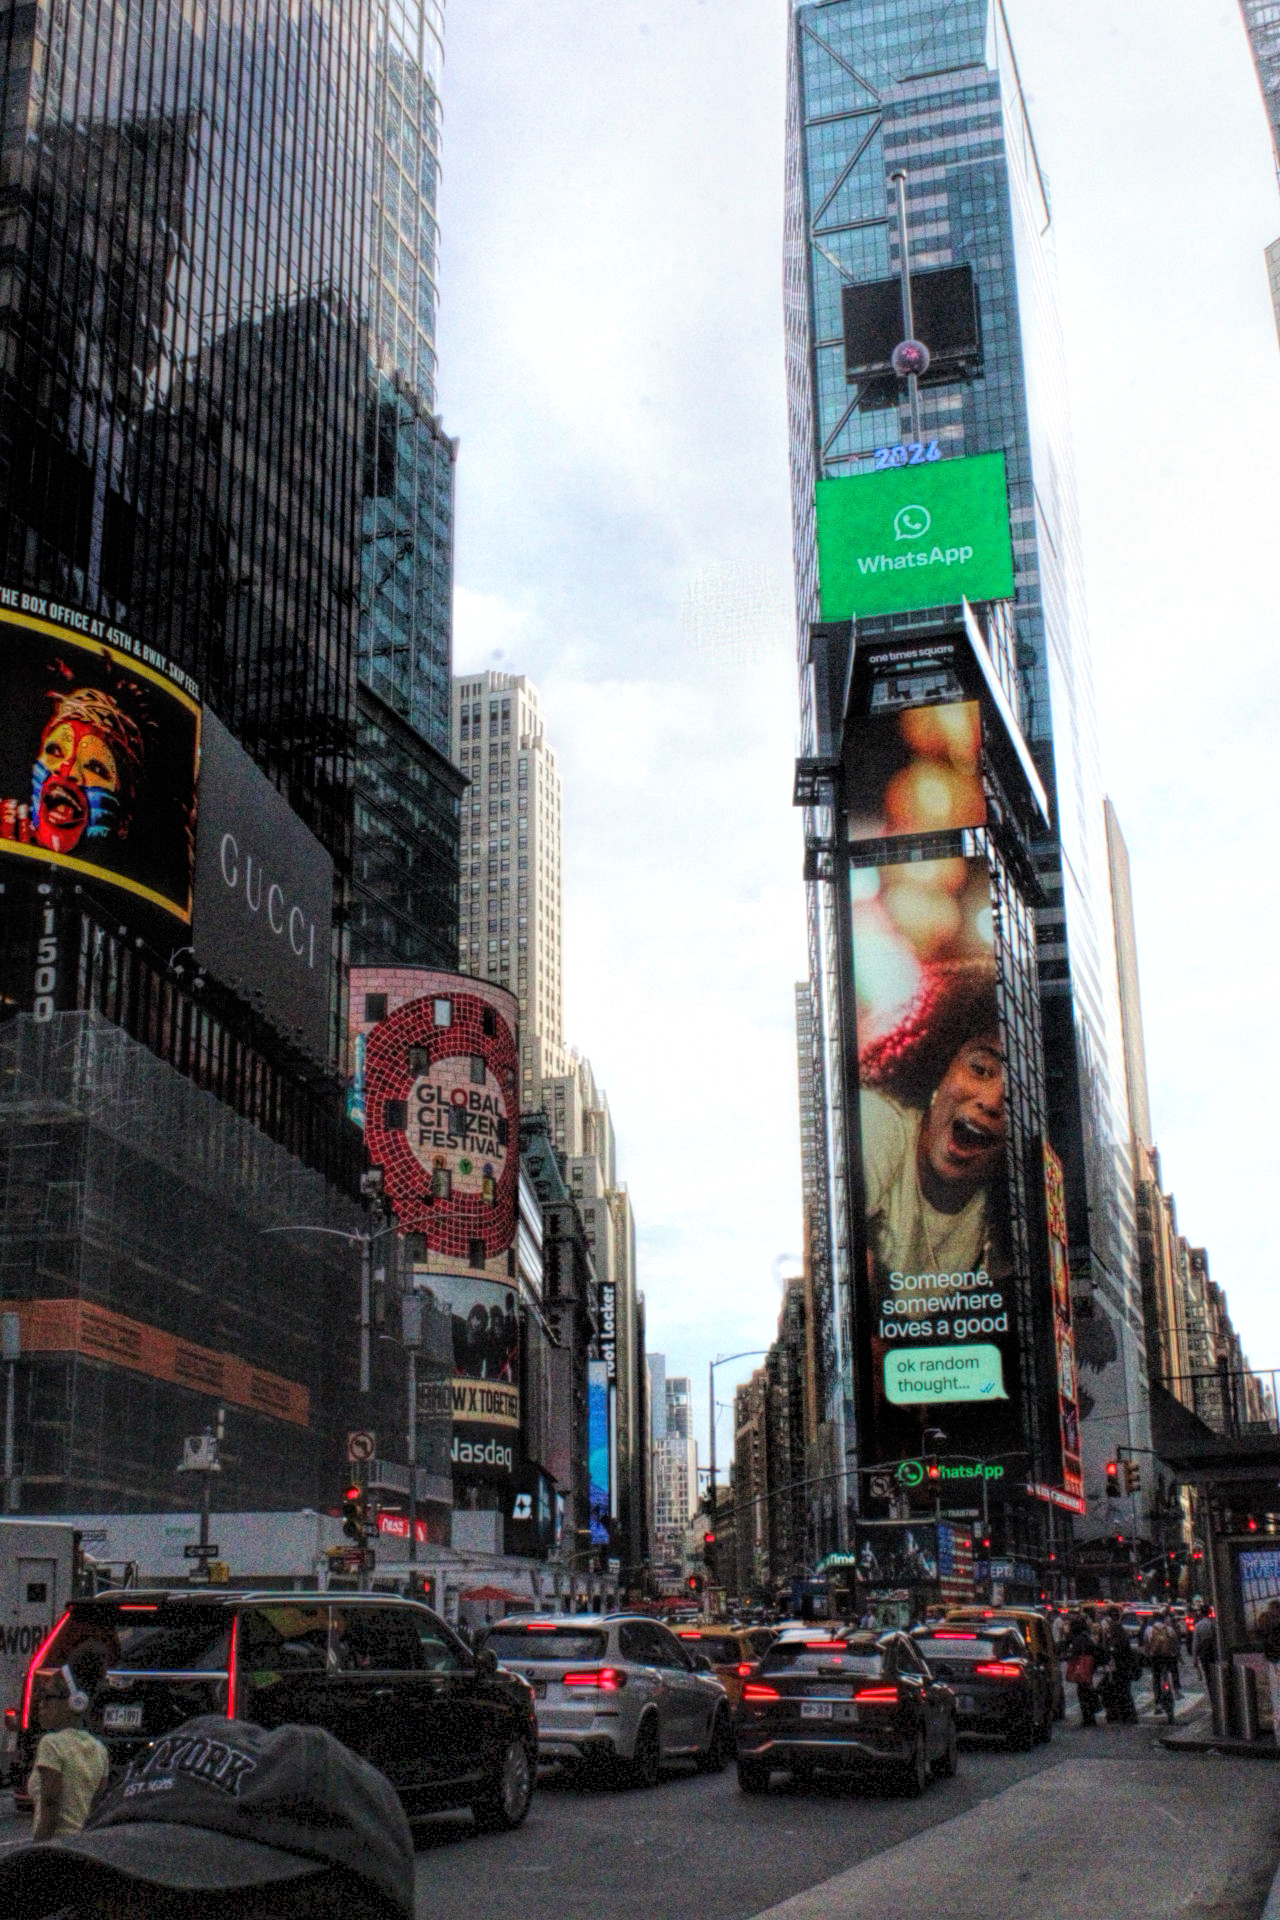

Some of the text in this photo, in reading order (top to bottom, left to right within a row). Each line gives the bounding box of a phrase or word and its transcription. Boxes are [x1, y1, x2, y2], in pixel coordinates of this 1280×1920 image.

[857, 545, 973, 574] WhatsApp
[21, 592, 48, 616] BOX
[49, 602, 90, 631] OFFICE
[90, 618, 105, 639] AT
[106, 626, 133, 652] 45TH
[132, 639, 141, 657] &
[168, 661, 185, 685] SKIP
[869, 645, 955, 664] one times square
[220, 833, 314, 968] GUCCI
[33, 908, 58, 1022] 1500
[416, 1084, 502, 1119] GLOBAL
[417, 1106, 499, 1137] CIZEN
[418, 1129, 503, 1159] FESTIVAL
[889, 1271, 993, 1291] Someone,
[600, 1286, 615, 1339] Locker
[882, 1291, 1002, 1315] somewhere
[879, 1312, 1008, 1339] loves a good
[897, 1357, 979, 1373] ok random
[468, 1387, 477, 1412] X
[898, 1376, 970, 1394] thought...
